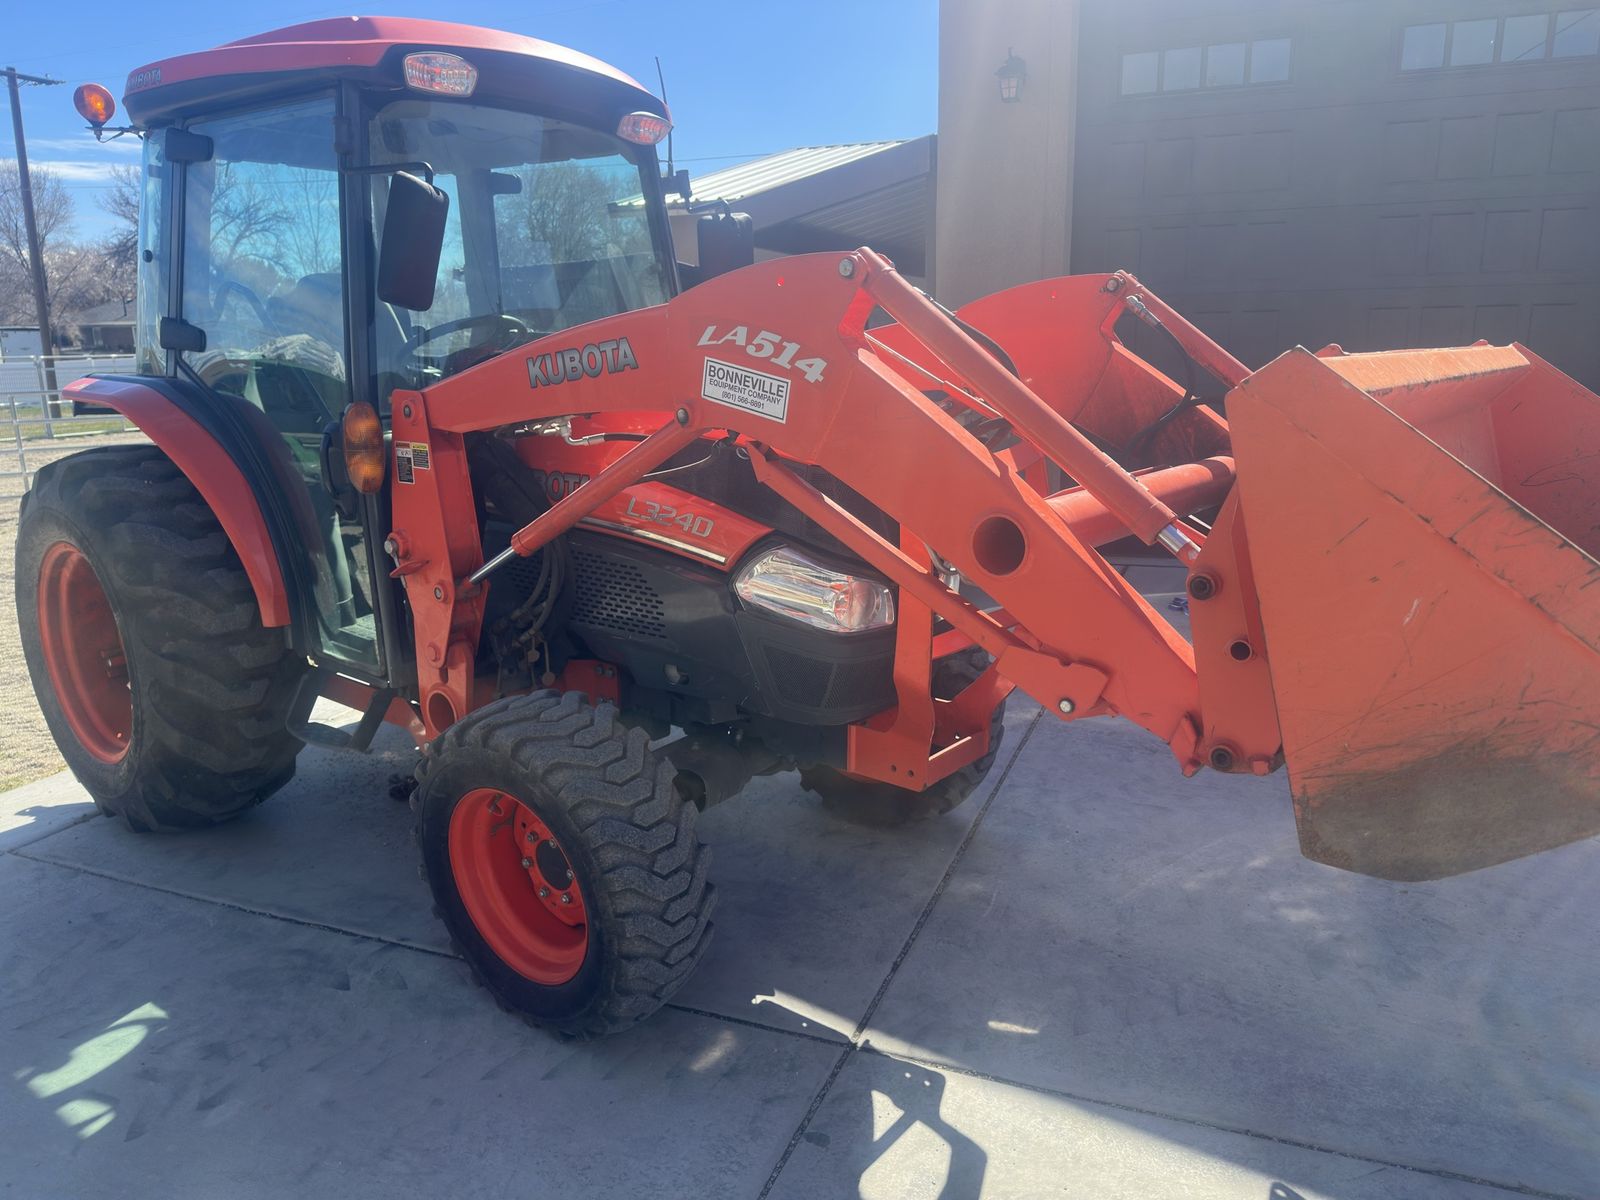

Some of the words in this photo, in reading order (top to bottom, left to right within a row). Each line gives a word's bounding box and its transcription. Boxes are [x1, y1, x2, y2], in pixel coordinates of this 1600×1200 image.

[526, 337, 639, 388] KUBOTA
[697, 325, 827, 383] LA514
[708, 365, 785, 398] BONNEVILLE
[709, 379, 746, 395] EQUIPMENT
[747, 389, 781, 405] COMPANY
[721, 390, 737, 403] (801)
[626, 496, 714, 537] L3240
